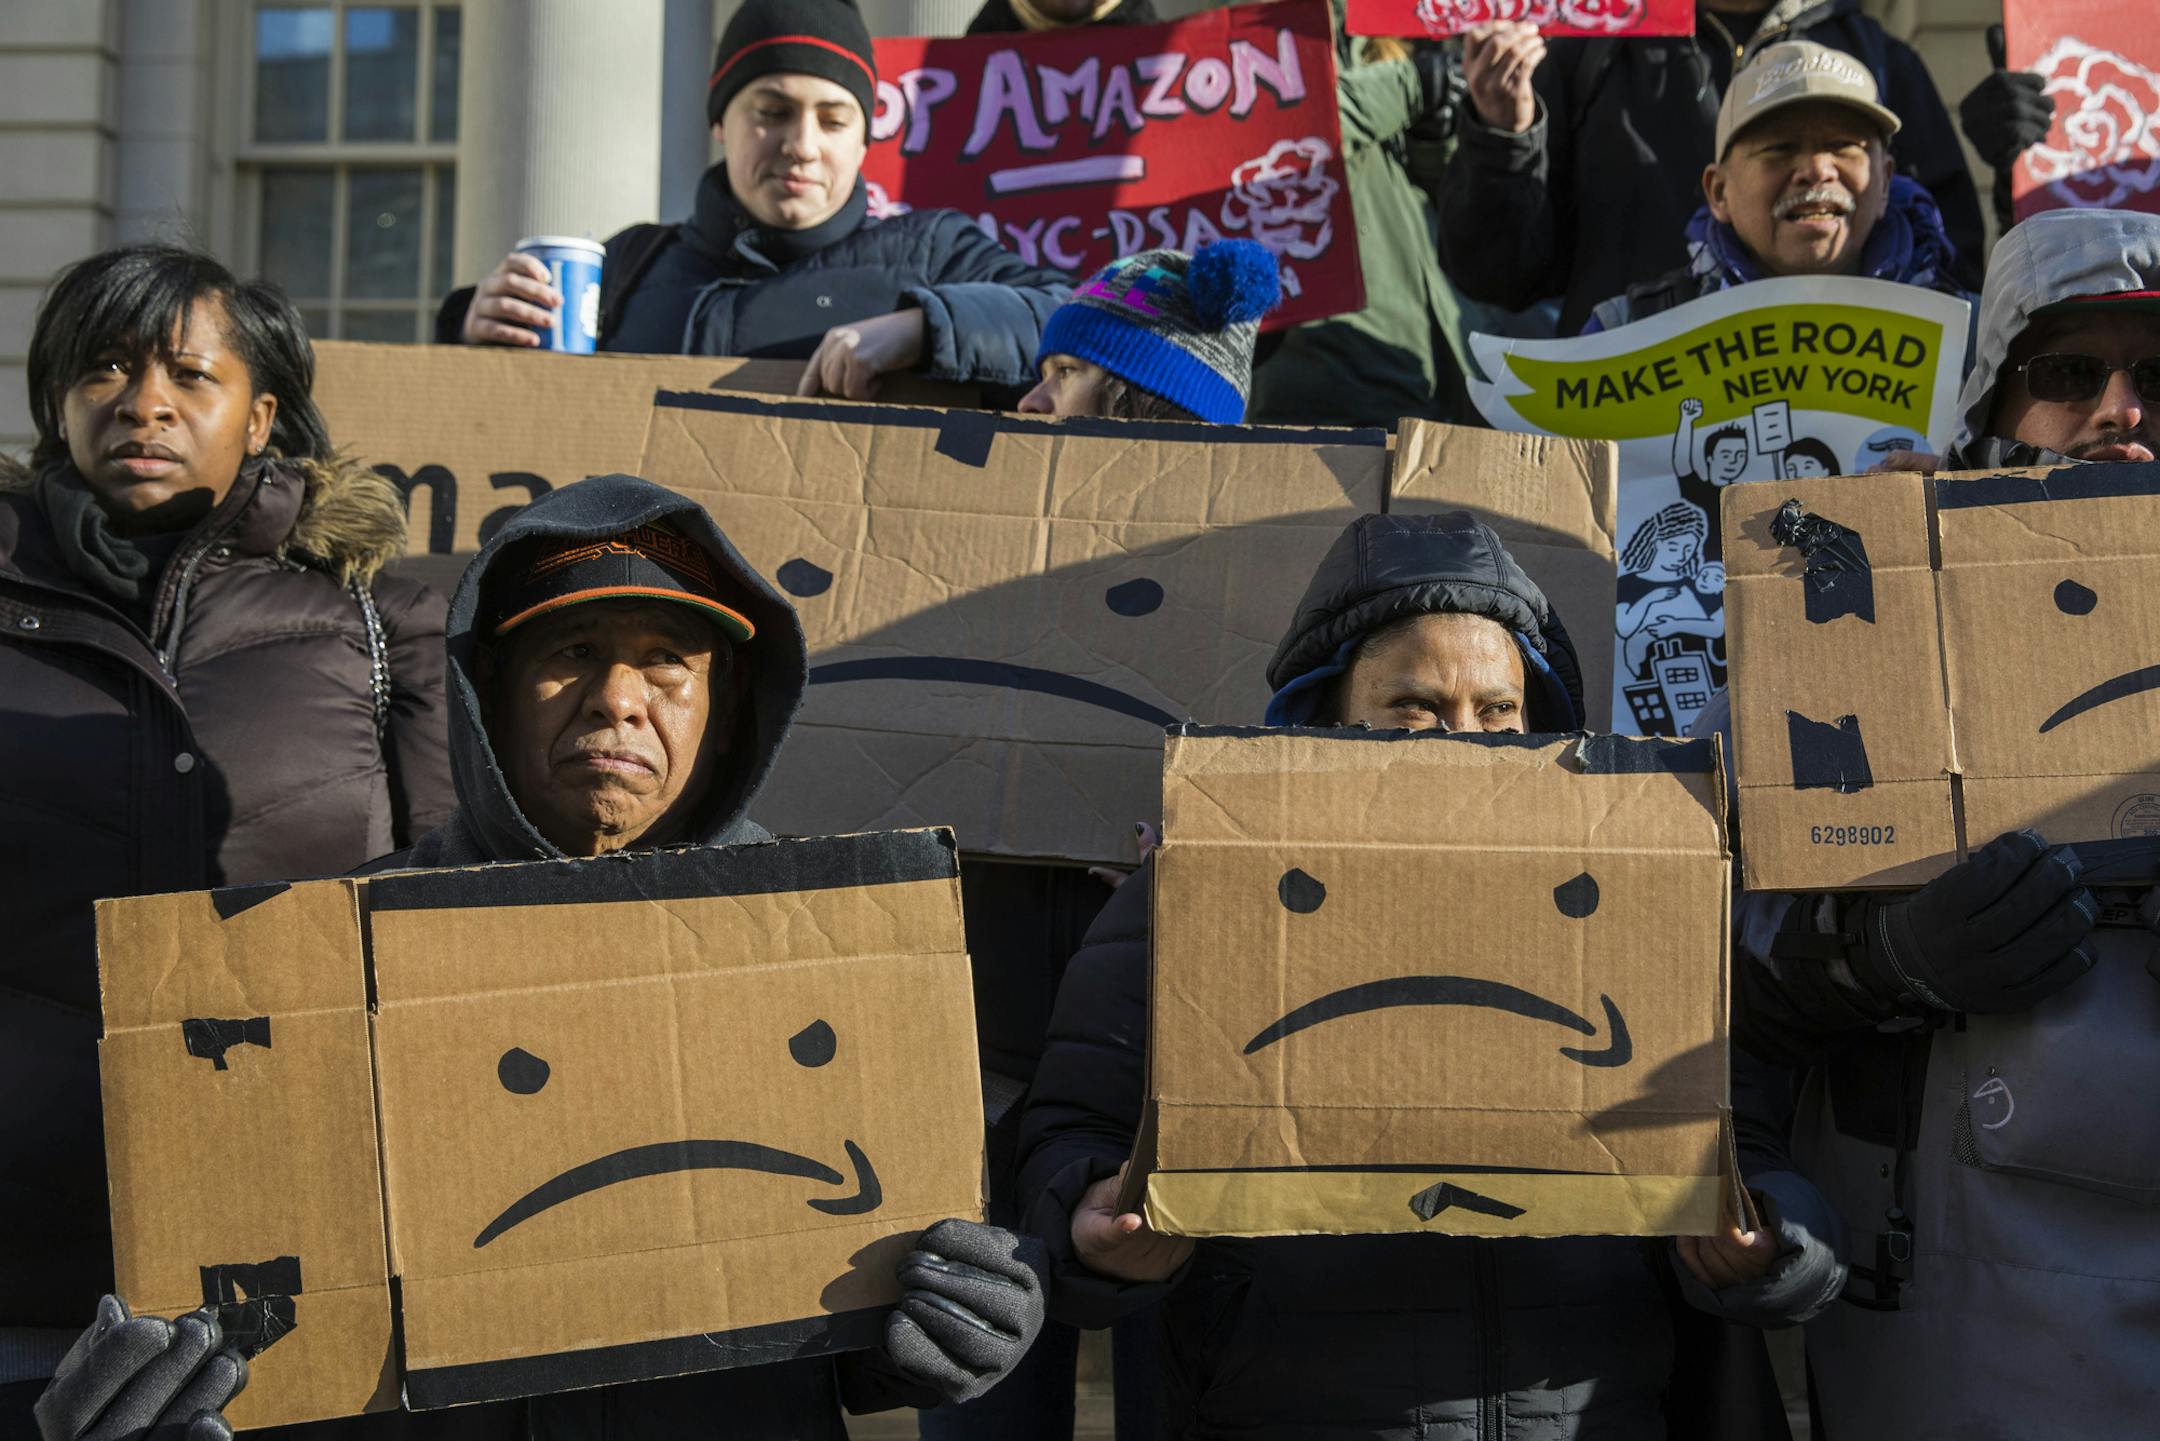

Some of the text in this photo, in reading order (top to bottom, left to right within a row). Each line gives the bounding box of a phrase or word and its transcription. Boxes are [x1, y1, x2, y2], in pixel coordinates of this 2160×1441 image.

[871, 29, 1307, 157] OP AMAZON
[1556, 321, 1927, 409] MAKE THE ROAD
[1723, 366, 1919, 410] NEW YORK
[371, 463, 566, 554] ma
[1811, 825, 1896, 846] 6298902
